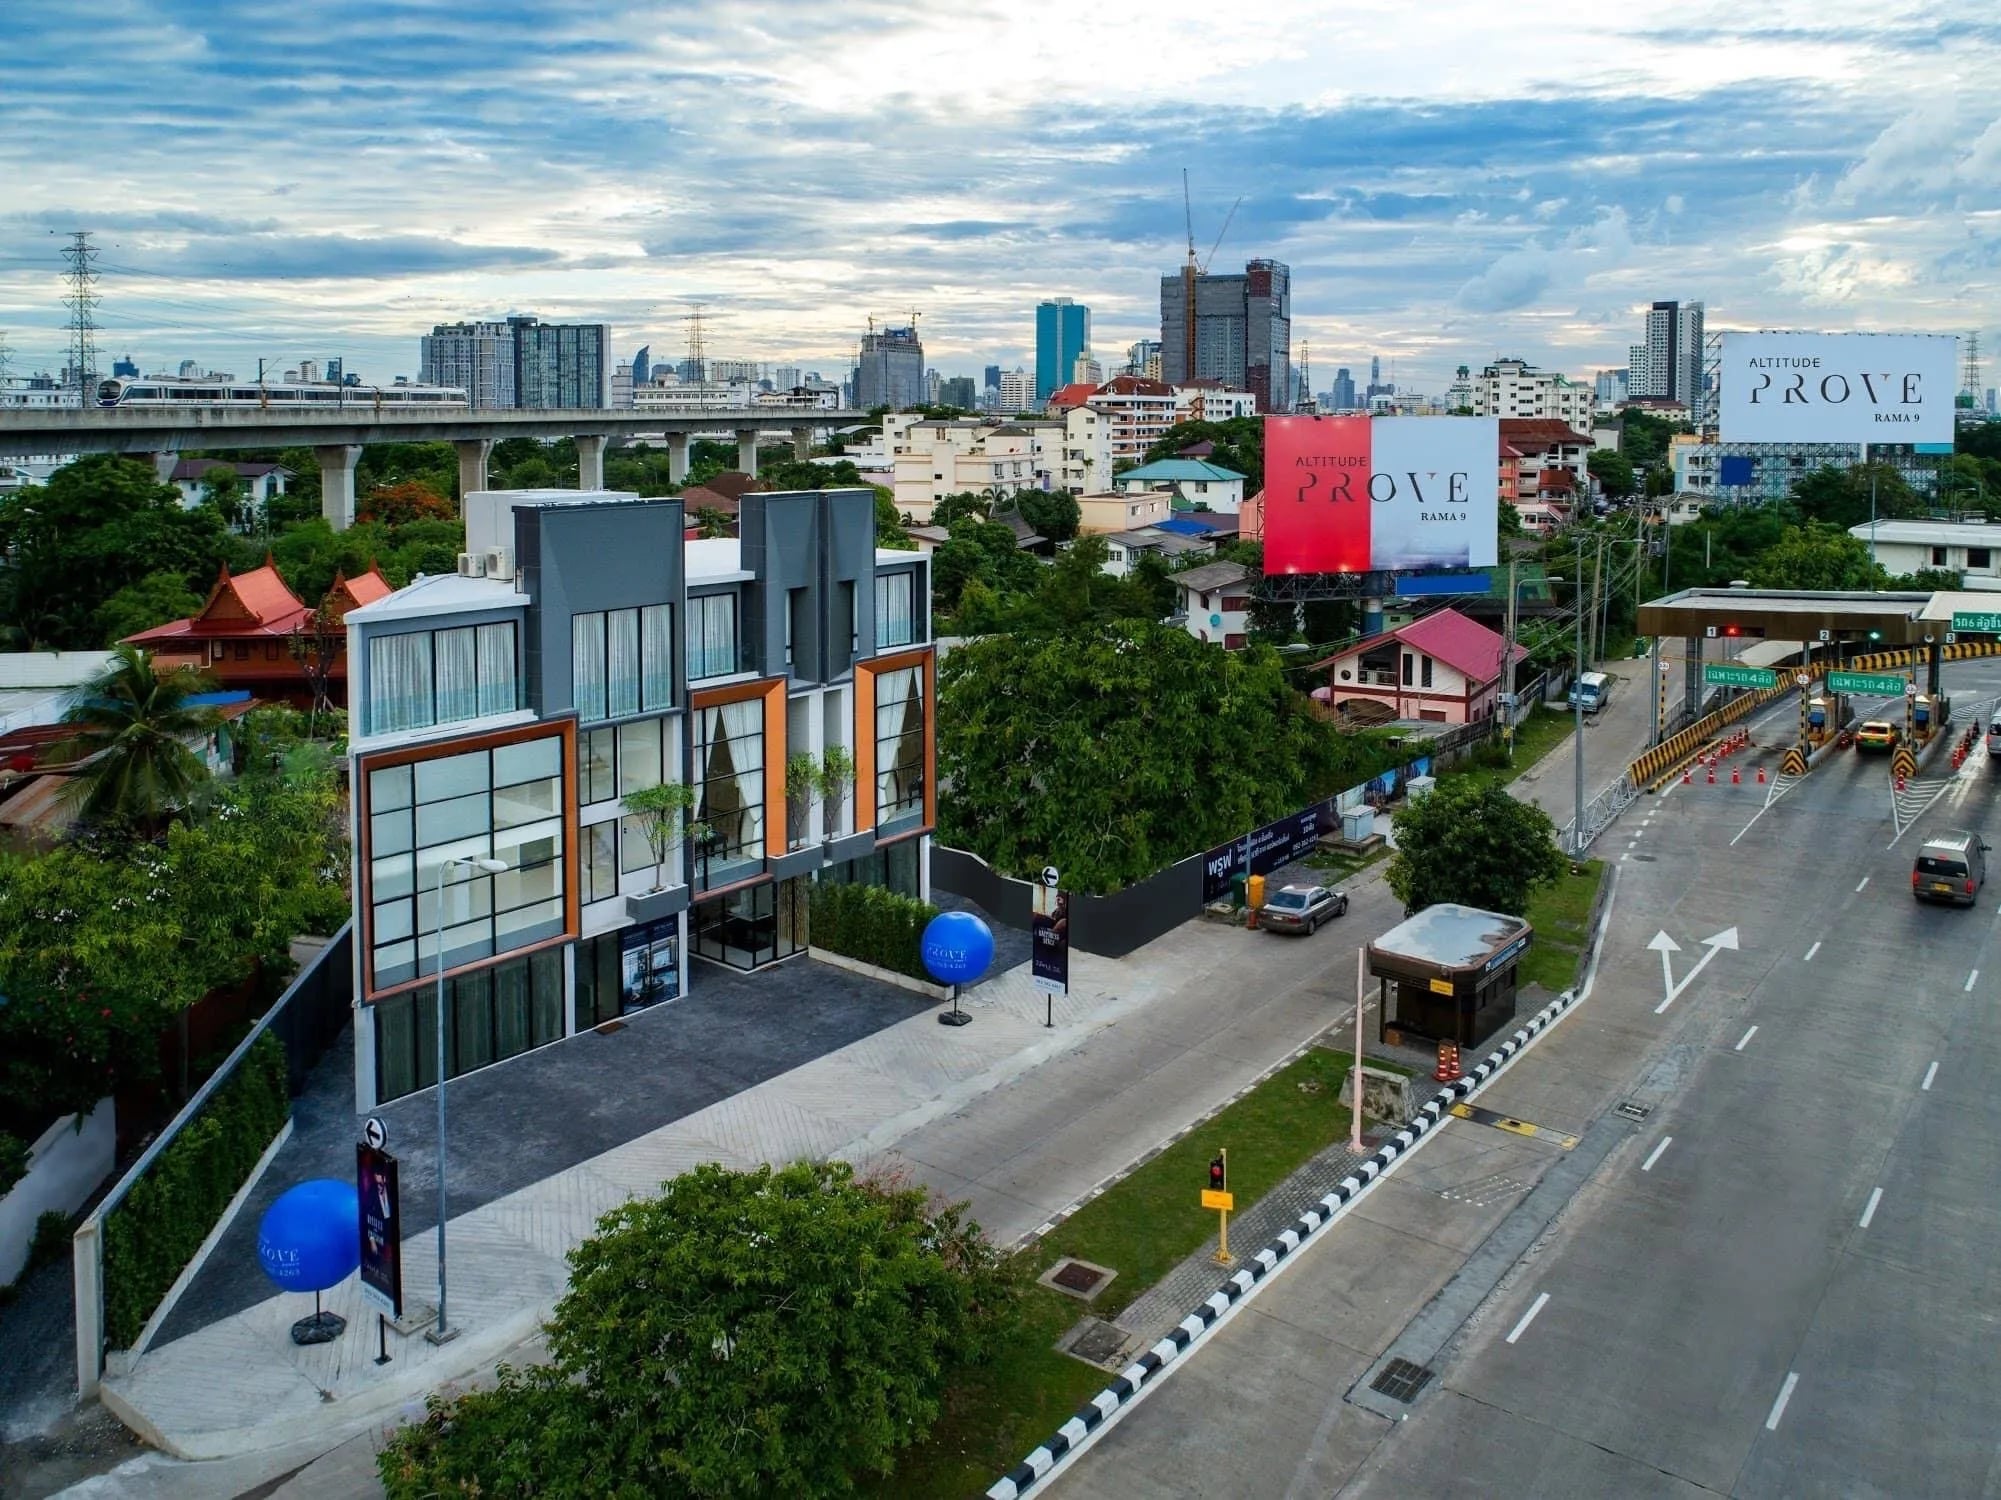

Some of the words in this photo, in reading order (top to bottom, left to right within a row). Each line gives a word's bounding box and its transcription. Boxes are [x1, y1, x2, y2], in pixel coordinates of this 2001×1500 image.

[1749, 357, 1822, 369] ALTITUDE
[1749, 373, 1922, 404] PROVE
[1874, 413, 1911, 423] RAMA
[1913, 413, 1920, 423] 9
[1296, 456, 1366, 467] ALTITUDE
[1297, 472, 1469, 503] PROVE
[1420, 512, 1458, 521] RAMA
[1460, 512, 1466, 521] 9
